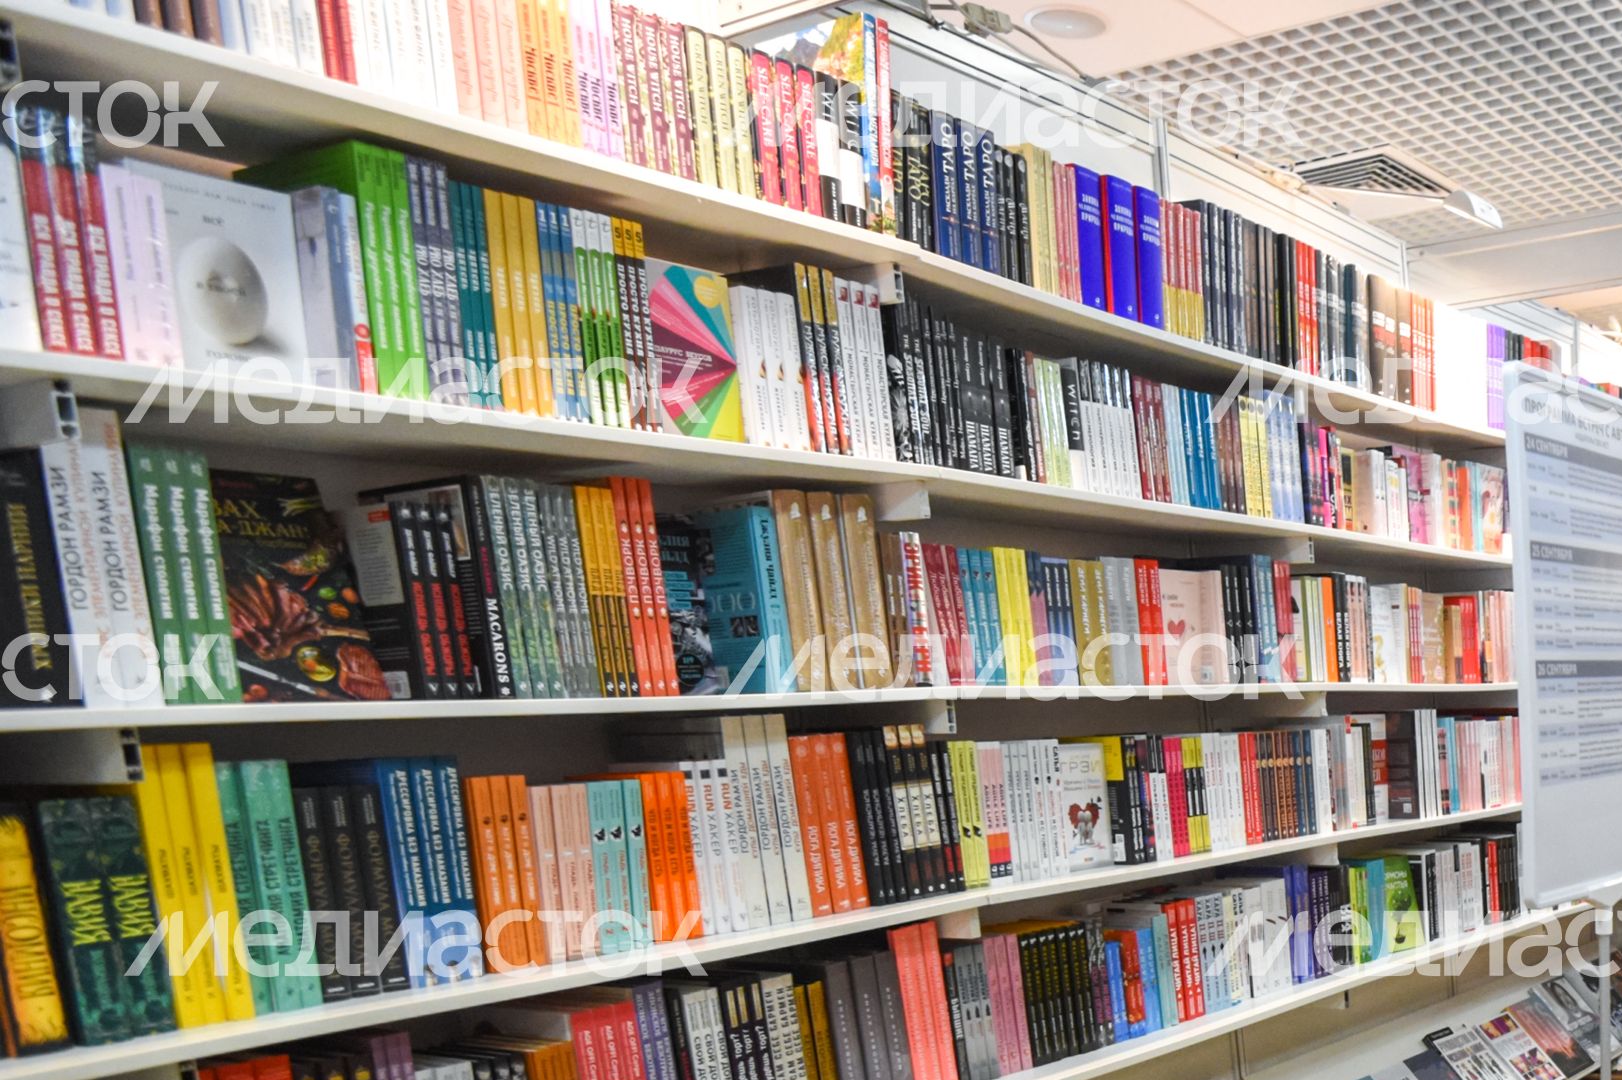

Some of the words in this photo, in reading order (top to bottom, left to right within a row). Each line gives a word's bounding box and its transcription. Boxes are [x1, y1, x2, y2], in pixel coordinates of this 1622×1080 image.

[50, 465, 77, 534] РАМЗИ
[91, 470, 117, 543] РАМЗИ
[60, 538, 88, 611] ГОРДОН
[104, 544, 129, 613] ГОРДОН
[143, 484, 163, 552] Марафон
[154, 555, 173, 620] столетия
[169, 486, 188, 554] Марафон
[180, 557, 199, 620] столетия
[194, 488, 214, 555] Марафон
[205, 558, 224, 620] столетия
[621, 538, 640, 604] ПЭЧВОРК
[635, 539, 654, 605] ПЭЧВОРК
[649, 539, 665, 605] ПЭЧВОРК
[486, 598, 510, 684] MACARONS
[731, 769, 744, 808] РАМЗИ
[752, 767, 766, 807] РАМЗИ
[773, 765, 786, 804] РАМЗИ
[735, 810, 749, 854] ГОРДОН
[756, 808, 771, 851] ГОРДОН
[777, 805, 793, 848] ГОРДОН
